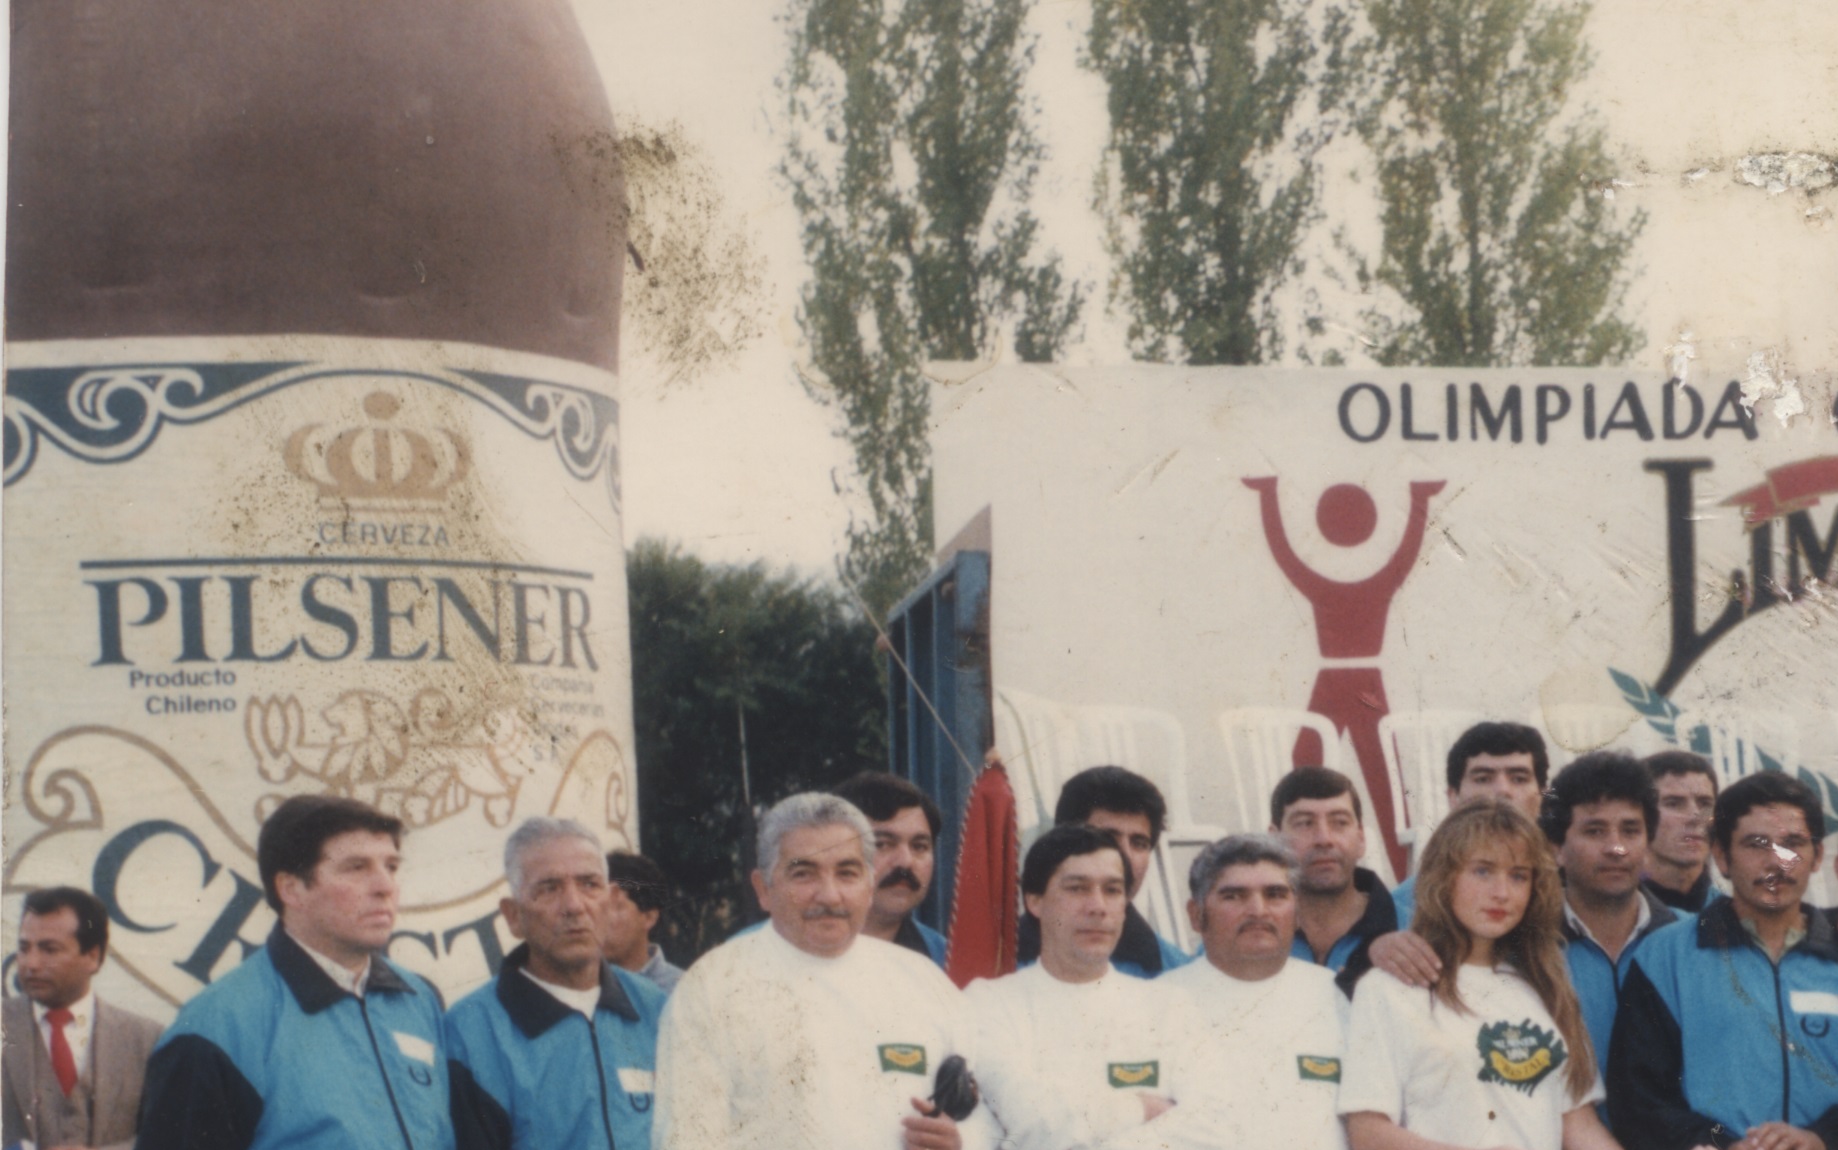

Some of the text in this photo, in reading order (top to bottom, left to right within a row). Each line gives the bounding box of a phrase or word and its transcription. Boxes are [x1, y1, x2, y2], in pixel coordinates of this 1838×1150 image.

[1337, 376, 1760, 446] OLIMPIADA
[317, 519, 450, 547] CERVEZA
[82, 573, 601, 672] PILSENER
[129, 667, 237, 689] Producto
[145, 692, 237, 716] Chileno
